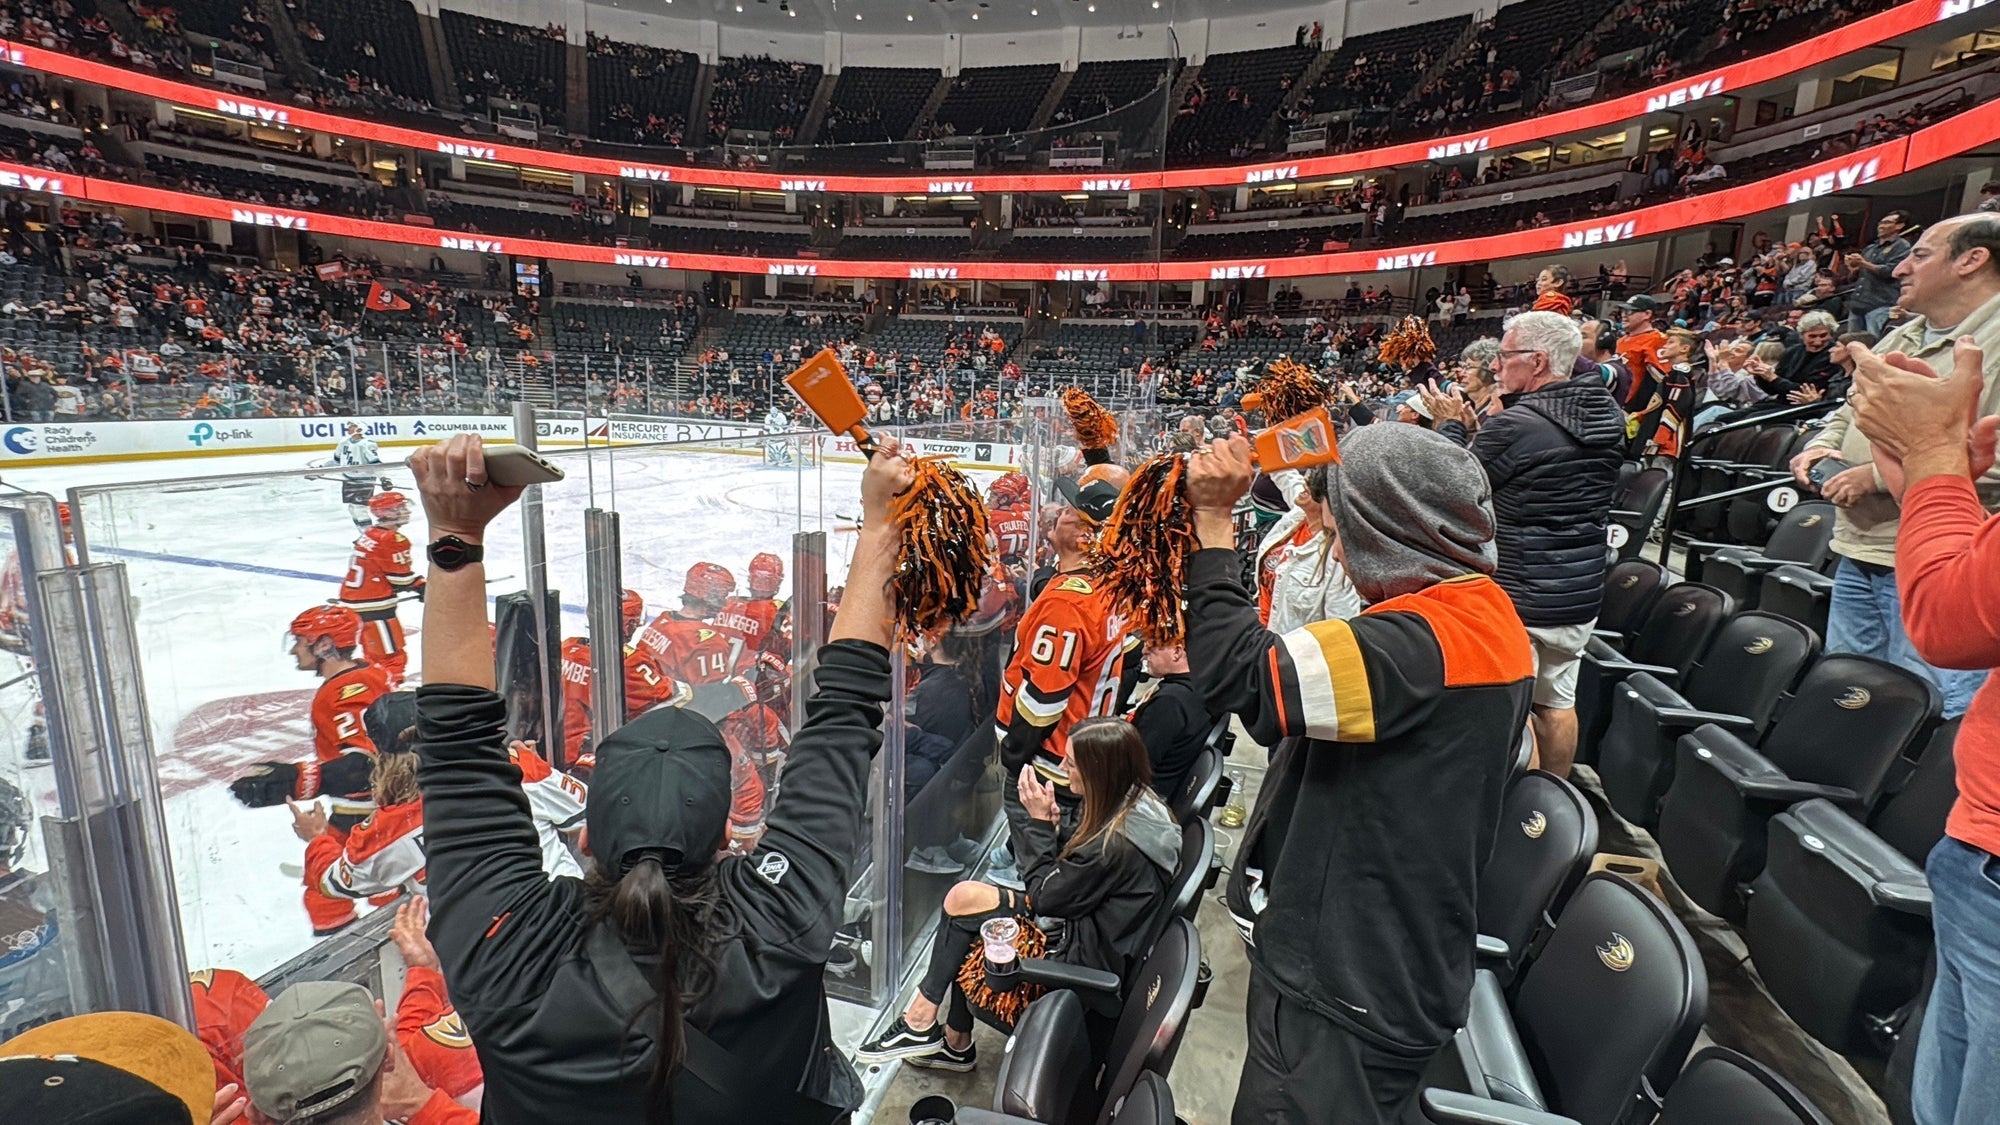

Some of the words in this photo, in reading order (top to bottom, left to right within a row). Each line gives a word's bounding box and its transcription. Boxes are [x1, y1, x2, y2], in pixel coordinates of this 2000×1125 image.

[0, 171, 63, 194] EY!
[44, 426, 72, 436] Rady
[216, 429, 253, 440] tp-link
[301, 423, 335, 437] UCI
[341, 422, 397, 436] Halth
[612, 423, 667, 433] MERCURY
[612, 432, 668, 441] INSURANCE
[47, 444, 83, 452] Health
[923, 444, 968, 453] VICTORY
[1777, 492, 1788, 507] G
[1610, 529, 1618, 543] F
[346, 551, 365, 588] 5
[1031, 625, 1077, 671] 61
[697, 652, 725, 677] 14
